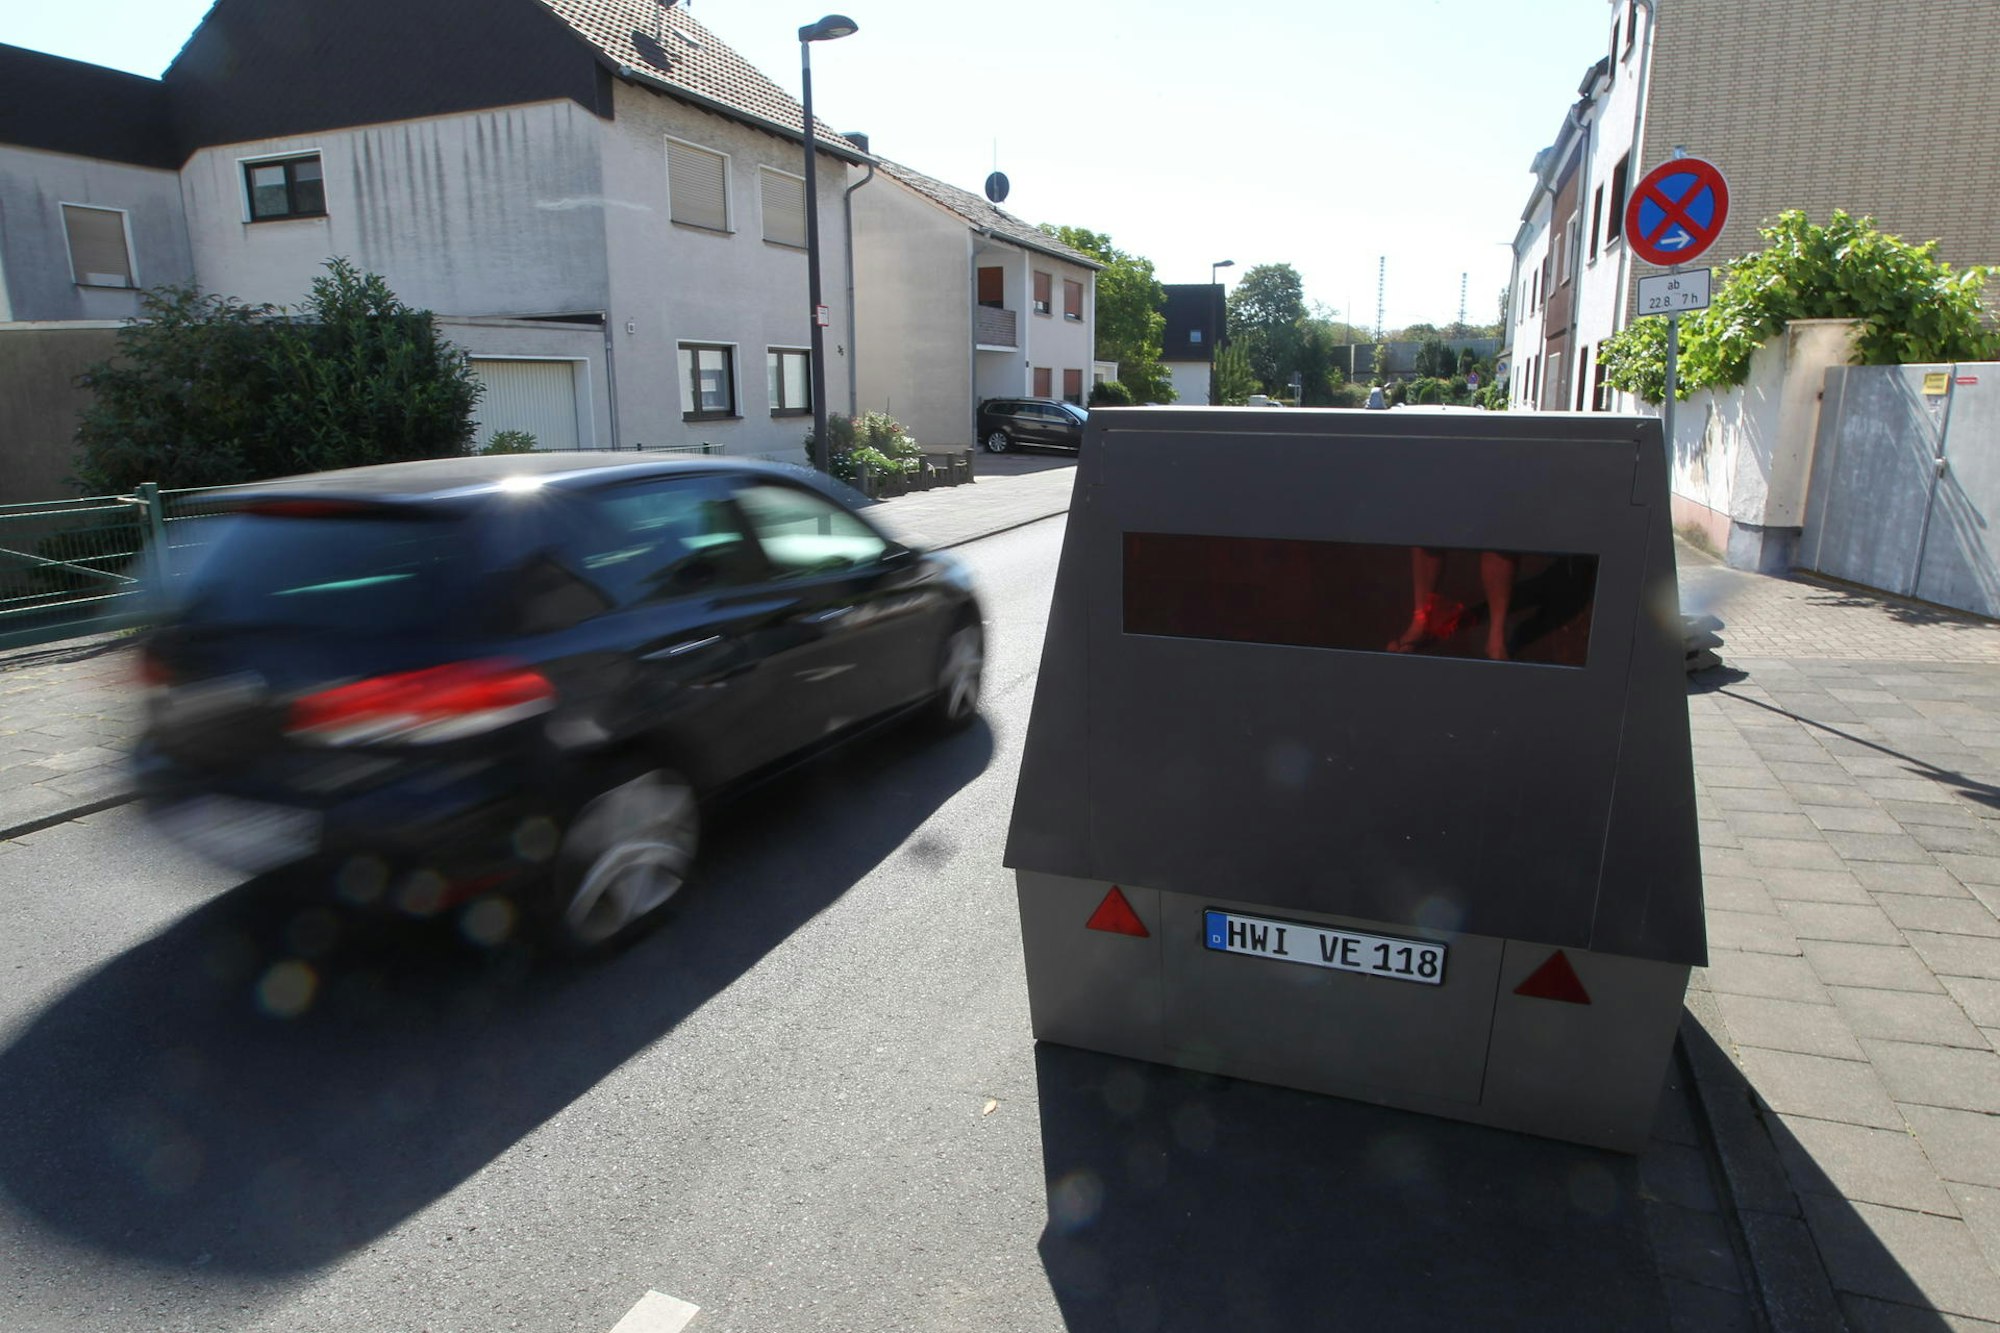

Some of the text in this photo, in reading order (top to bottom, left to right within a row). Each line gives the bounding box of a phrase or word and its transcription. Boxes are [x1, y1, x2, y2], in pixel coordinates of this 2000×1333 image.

[1667, 279, 1680, 290] ab
[1682, 293, 1688, 304] 7
[1691, 293, 1698, 304] h
[1227, 920, 1437, 978] HWI VE 118
